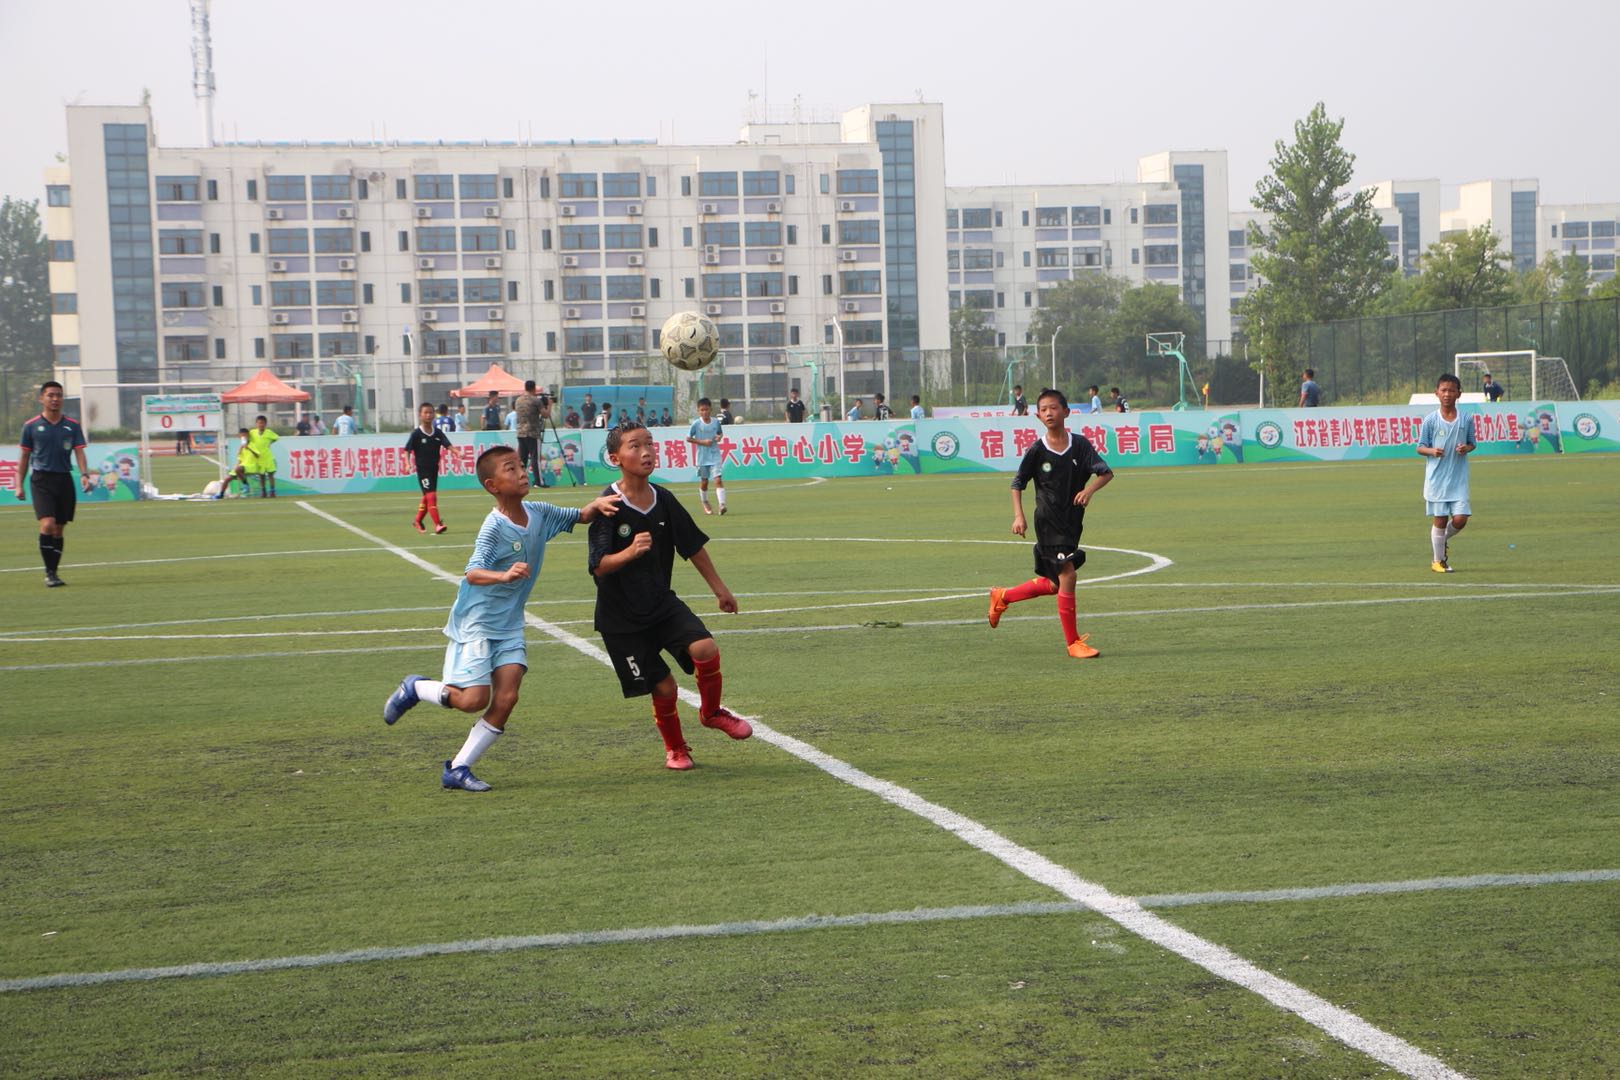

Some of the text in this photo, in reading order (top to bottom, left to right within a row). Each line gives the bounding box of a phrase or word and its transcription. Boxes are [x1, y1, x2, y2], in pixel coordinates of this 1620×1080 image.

[161, 414, 205, 428] 0 1
[653, 434, 865, 468] 豫大兴中心小学
[980, 425, 1174, 458] 宿豫教育局
[626, 656, 640, 676] 5
